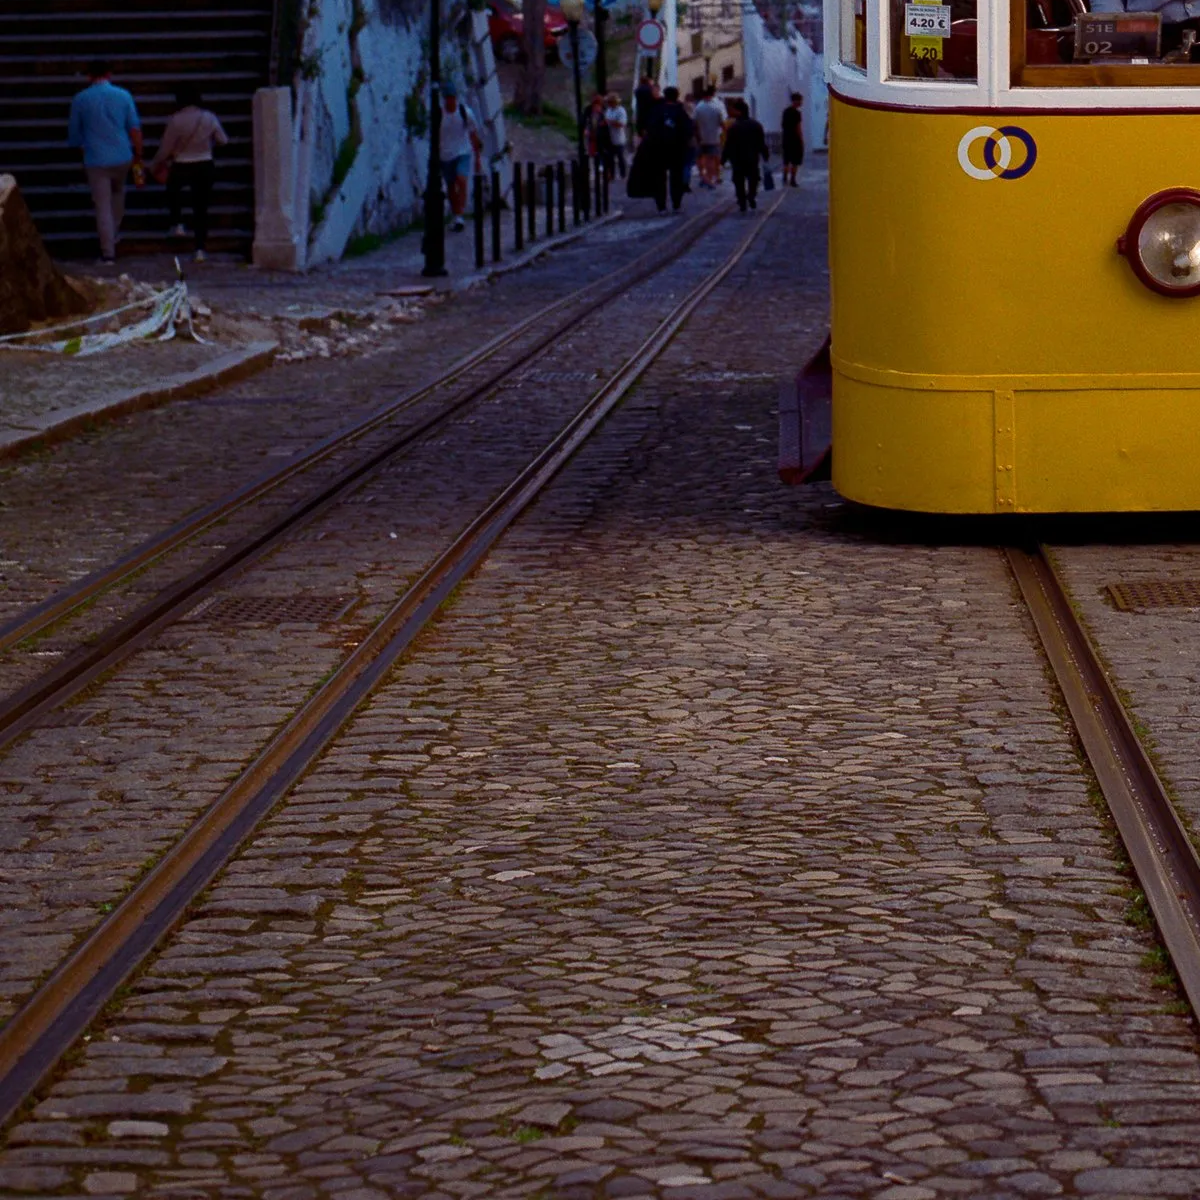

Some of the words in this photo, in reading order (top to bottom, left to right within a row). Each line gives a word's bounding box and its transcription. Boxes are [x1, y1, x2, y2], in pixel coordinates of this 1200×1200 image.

[910, 18, 935, 28] 4.20
[938, 19, 946, 29] €
[1084, 41, 1113, 55] 02
